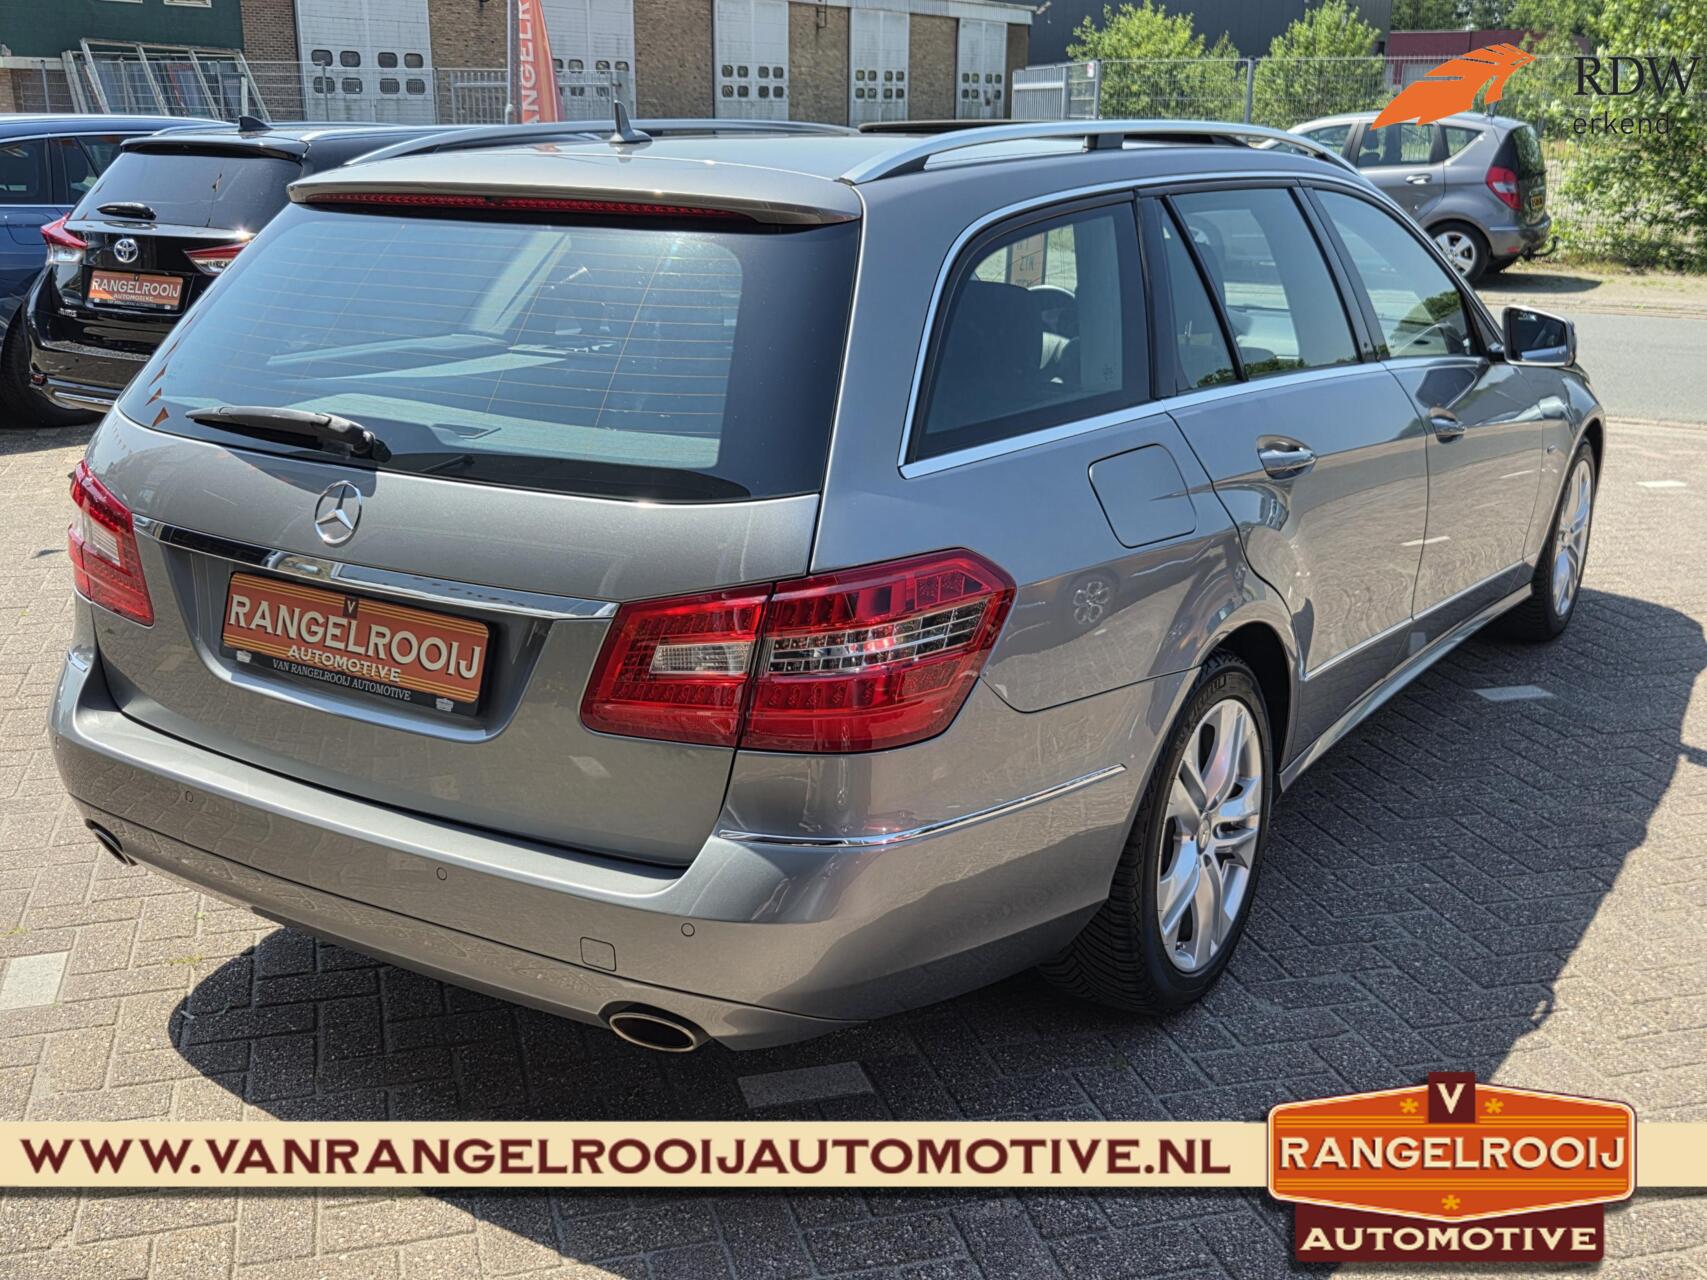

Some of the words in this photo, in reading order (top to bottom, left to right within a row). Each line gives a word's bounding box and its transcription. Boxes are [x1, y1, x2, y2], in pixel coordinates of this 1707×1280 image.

[91, 279, 180, 297] RANGELROOIJ
[346, 600, 356, 614] V
[228, 594, 482, 679] RANGELROOIJ
[272, 658, 290, 672] VAN
[290, 662, 351, 687] RANGELROOIJ
[351, 678, 412, 701] AUTOMOTIVE
[288, 645, 402, 682] AUTOMOTIVE
